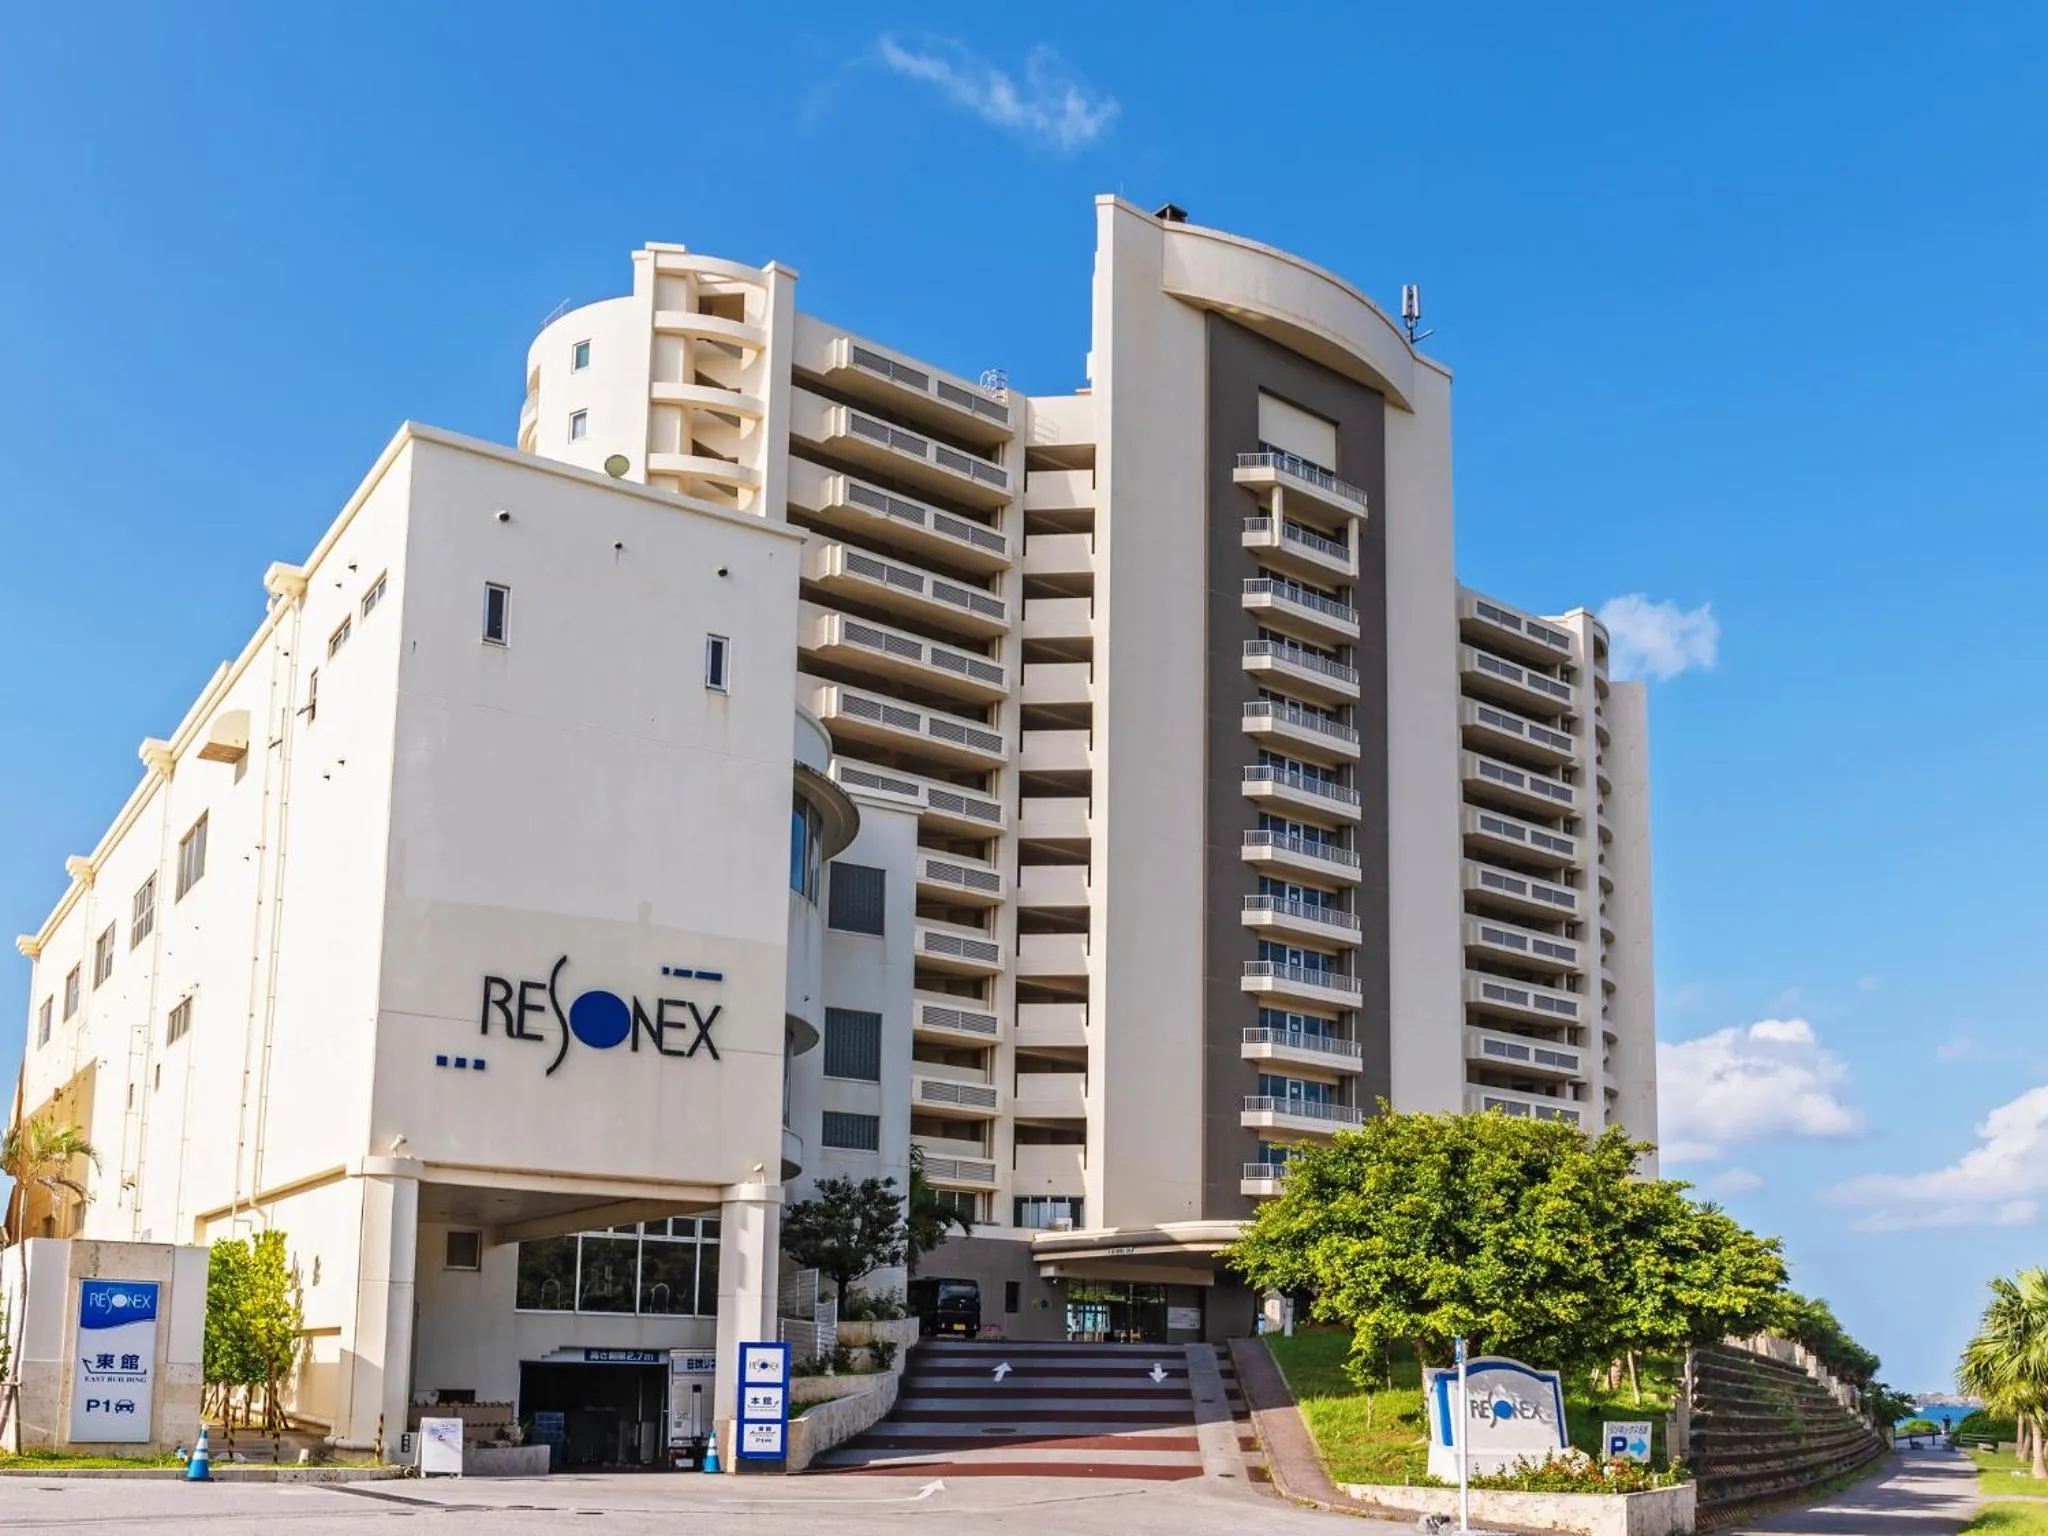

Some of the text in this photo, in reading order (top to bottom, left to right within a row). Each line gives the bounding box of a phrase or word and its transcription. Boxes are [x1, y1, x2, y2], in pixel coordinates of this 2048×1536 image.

[480, 955, 722, 1076] RESONEX
[90, 1286, 152, 1315] RESONEX
[96, 1353, 140, 1370] 東館
[86, 1399, 110, 1413] P1
[1470, 1391, 1543, 1429] RESONEX
[1610, 1436, 1628, 1457] P
